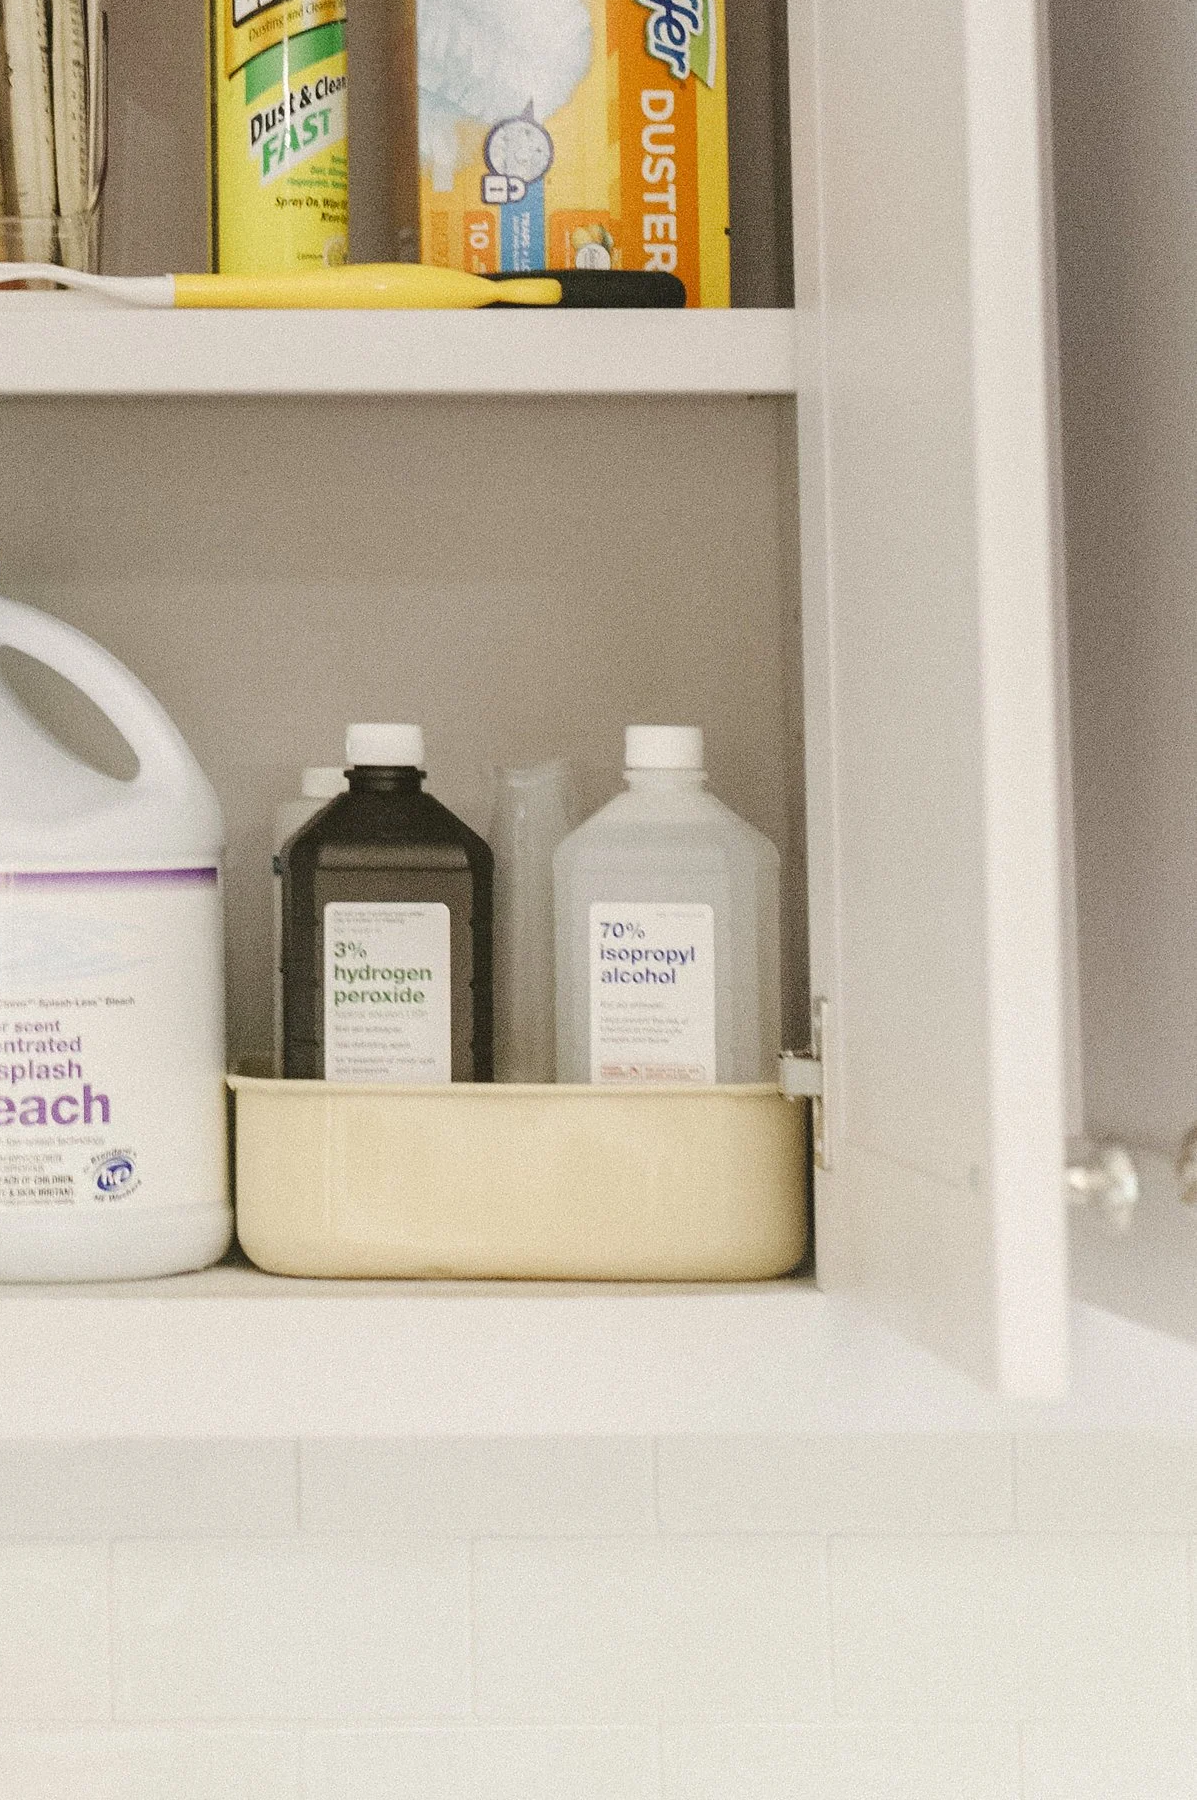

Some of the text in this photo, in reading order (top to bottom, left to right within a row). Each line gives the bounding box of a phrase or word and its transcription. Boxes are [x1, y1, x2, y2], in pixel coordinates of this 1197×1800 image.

[250, 93, 295, 148] Dust
[296, 84, 312, 111] &
[261, 107, 333, 178] FAST
[640, 89, 678, 273] DUSTER
[275, 197, 303, 209] Spray
[468, 221, 491, 250] 10
[599, 921, 647, 940] 70%
[333, 941, 368, 960] 3%
[599, 944, 696, 966] isopropyl
[333, 963, 433, 986] hydrogen
[600, 967, 677, 984] alcohol
[104, 996, 136, 1007] Bleach
[333, 986, 426, 1009] peroxide
[13, 1020, 61, 1034] scent
